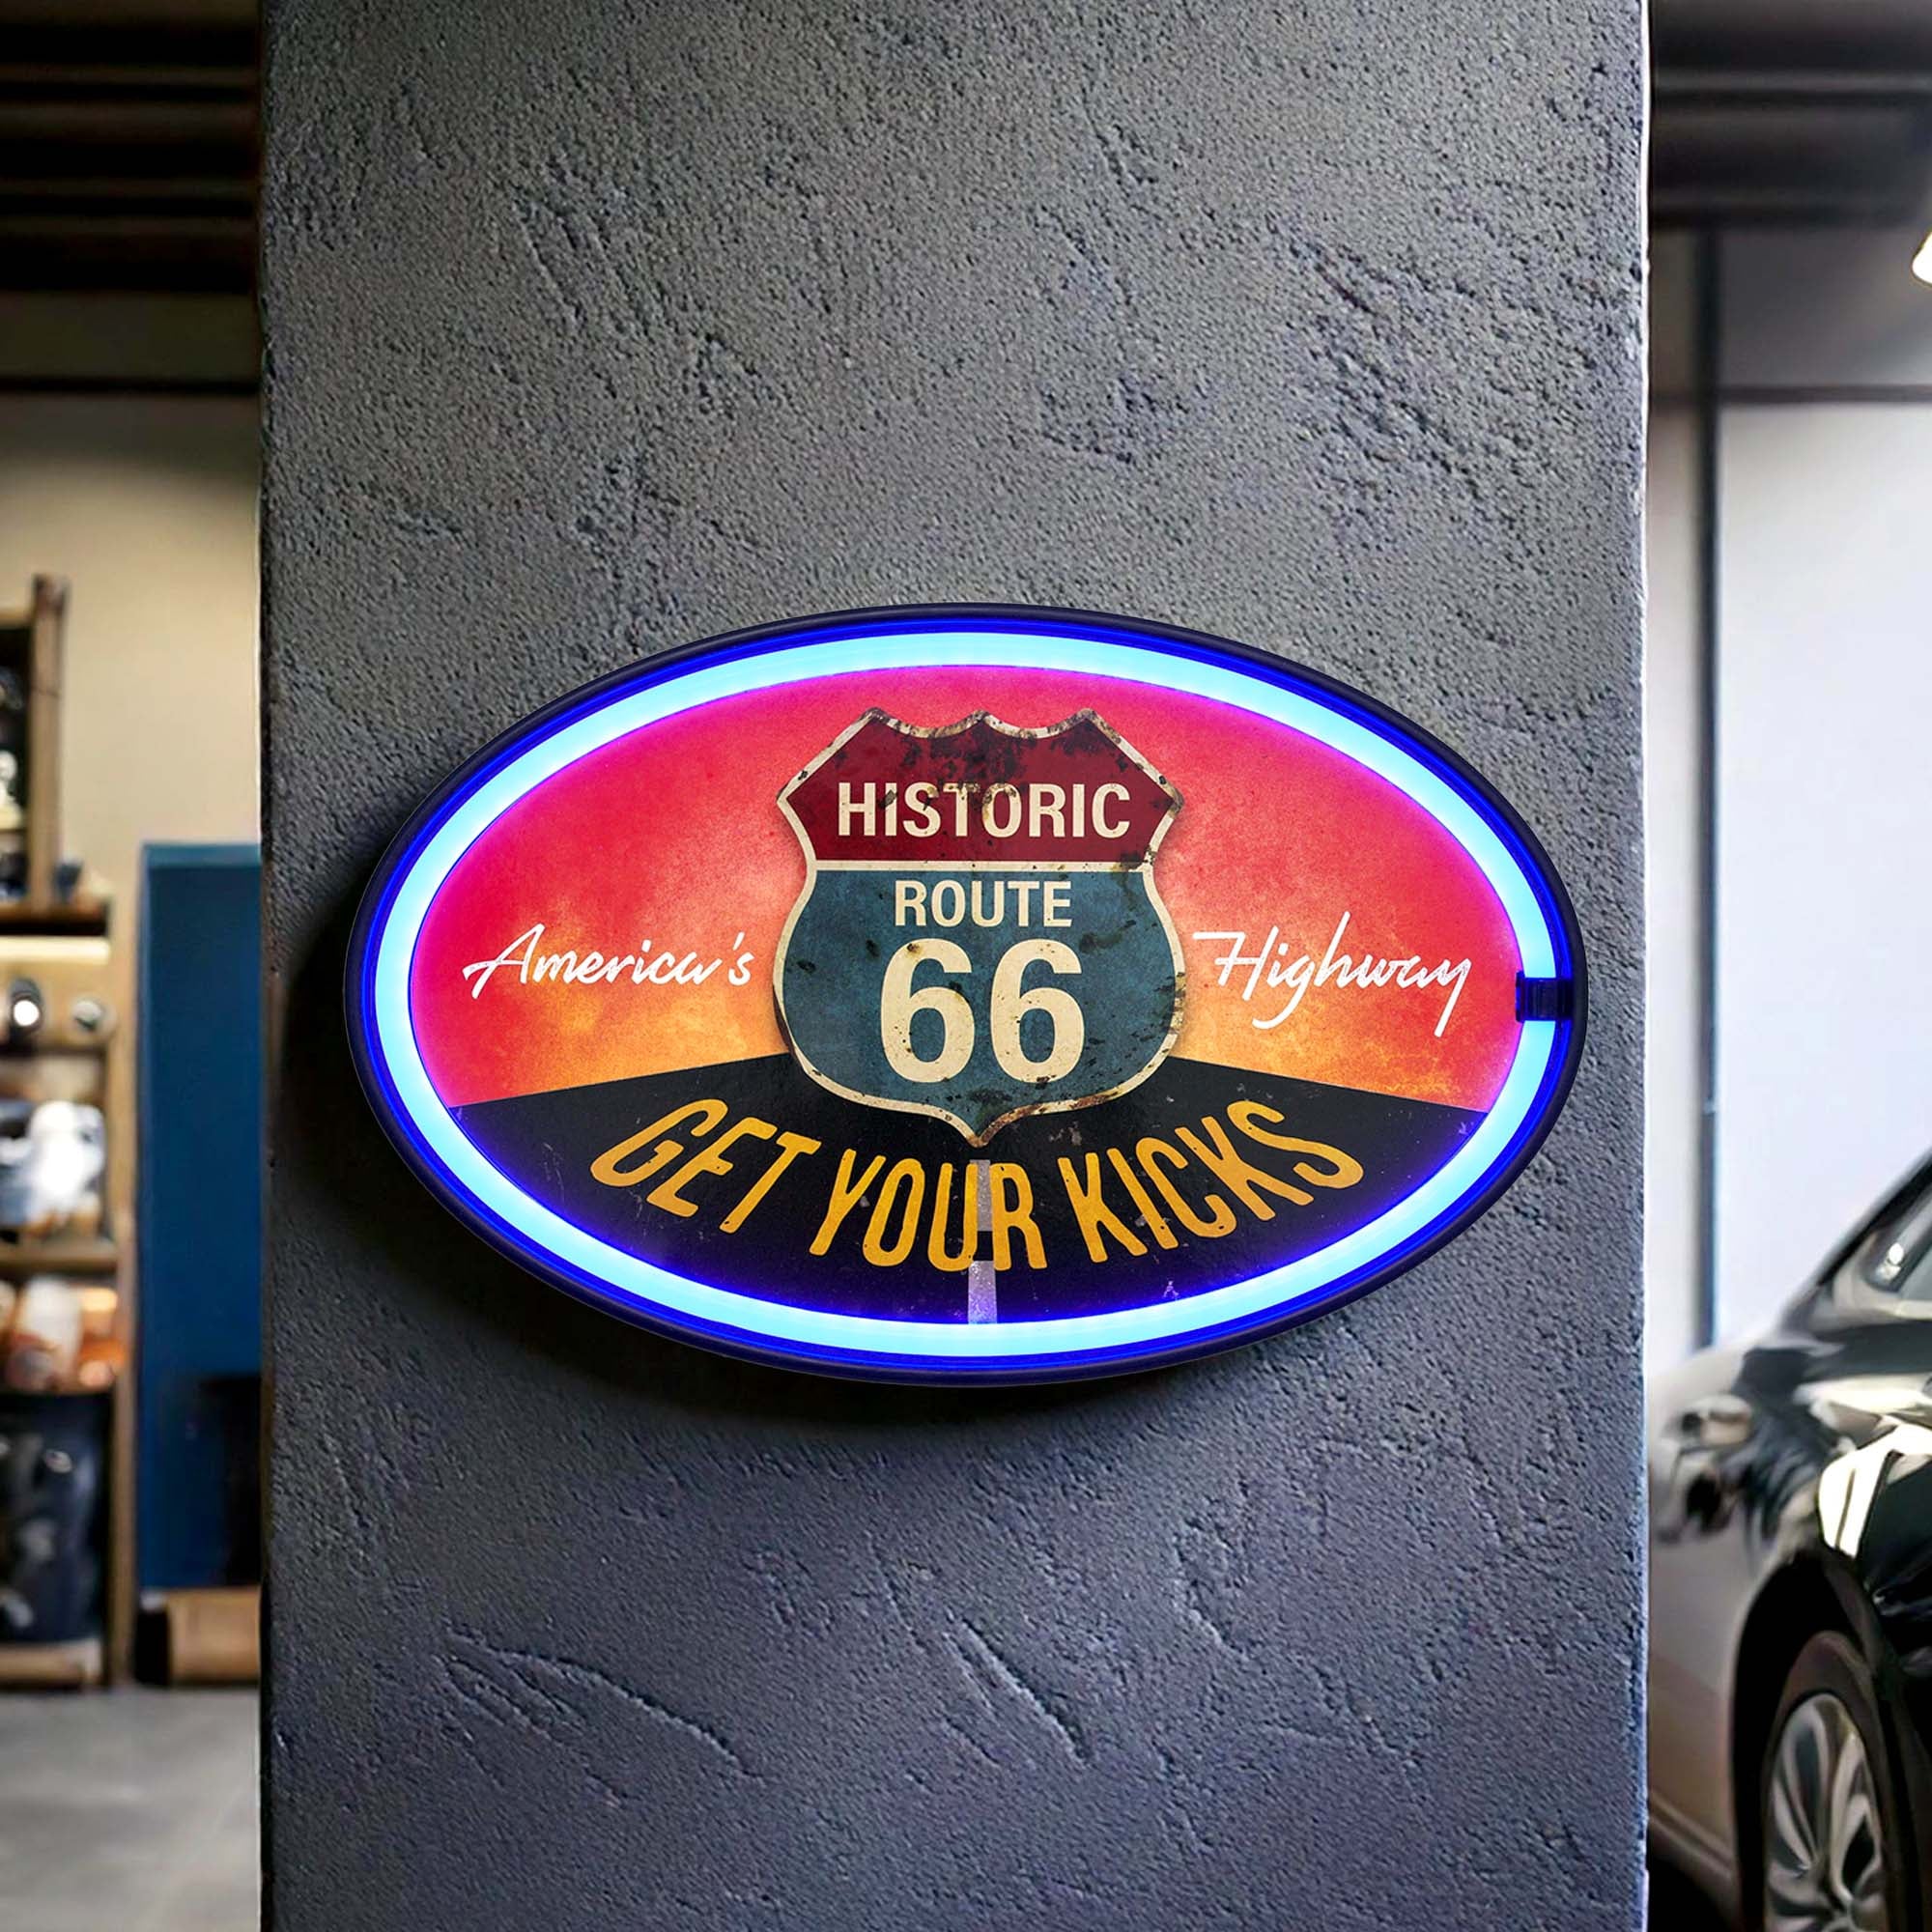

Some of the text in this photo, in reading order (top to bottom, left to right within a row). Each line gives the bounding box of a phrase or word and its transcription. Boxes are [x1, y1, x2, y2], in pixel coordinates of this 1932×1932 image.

[838, 781, 1130, 838] HISTORIC
[895, 879, 1072, 927] ROUTE
[463, 923, 753, 999] America's
[880, 938, 1085, 1083] 66
[1192, 911, 1471, 1037] Highway
[590, 1098, 1363, 1271] GET YOUR KICKS
